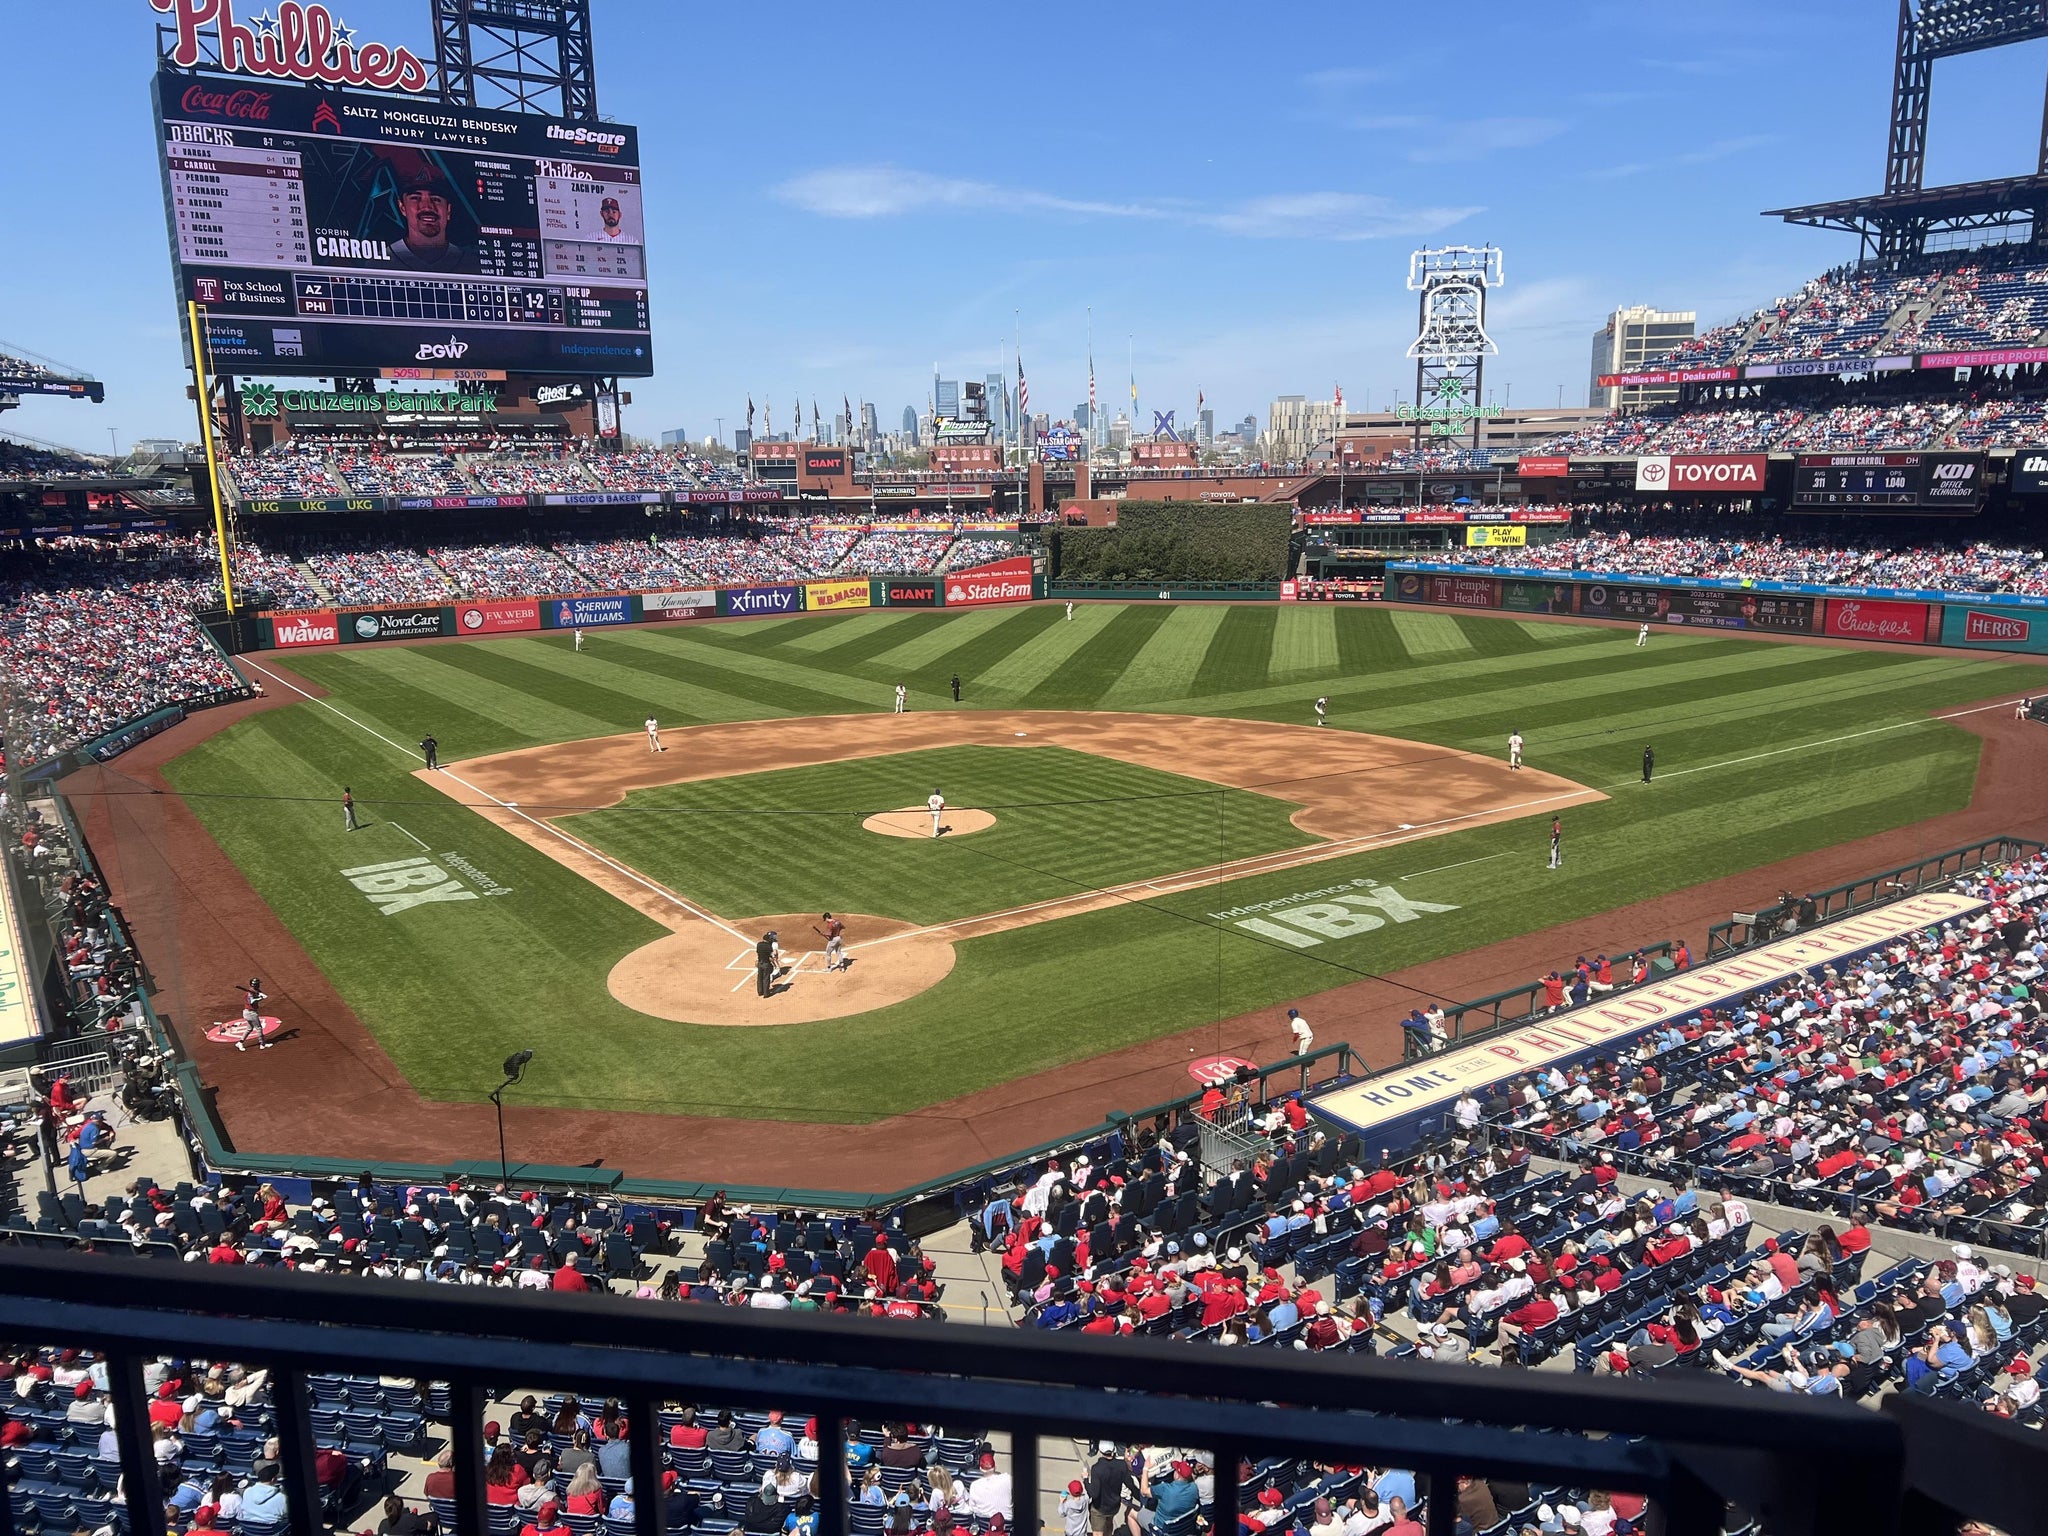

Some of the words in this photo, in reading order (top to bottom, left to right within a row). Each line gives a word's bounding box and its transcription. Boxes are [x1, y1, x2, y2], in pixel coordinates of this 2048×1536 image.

[150, 0, 428, 92] Phillies
[181, 84, 272, 120] Coca-Cola
[343, 105, 378, 119] SALTZ
[383, 110, 457, 128] MONGELUZZI
[462, 119, 518, 134] BENDESKY
[380, 126, 425, 139] INJURY
[434, 132, 488, 145] LAWYERS
[546, 125, 626, 147] theScore
[183, 148, 211, 158] VARGAS
[184, 161, 216, 171] CARROLL
[283, 169, 299, 178] 1.040
[488, 162, 511, 171] SEQUENCE
[535, 159, 593, 181] Phillies
[186, 173, 220, 183] PERDOMO
[187, 186, 229, 197] FERNANDEZ
[571, 182, 590, 193] ZACH
[591, 184, 605, 194] POP
[189, 199, 222, 208] ARENADO
[192, 224, 223, 233] MCCANN
[315, 227, 349, 237] CORBIN
[499, 228, 513, 236] STATS
[194, 236, 223, 245] THOMAS
[195, 249, 228, 258] BARROSA
[316, 236, 391, 261] CARROLL
[223, 280, 244, 291] Fox
[246, 281, 282, 293] School
[224, 292, 237, 301] of
[239, 293, 286, 304] Business
[305, 284, 322, 295] AZ
[526, 293, 545, 309] 1-2
[567, 287, 580, 297] DUE
[581, 288, 590, 298] UP
[305, 301, 326, 312] PHI
[580, 299, 600, 307] TURNER
[581, 309, 611, 318] SCHWARBER
[581, 319, 601, 327] HARPER
[205, 327, 243, 337] Driving
[206, 347, 262, 355] outcomes.
[419, 344, 462, 360] PGW
[561, 344, 631, 355] Independence
[1927, 355, 1960, 366] WHEY
[1963, 352, 2005, 364] BETTER
[393, 368, 421, 379] 5050
[1776, 363, 1824, 376] LISCIO'S
[1828, 360, 1876, 373] BAKERY
[454, 370, 488, 379] $30,190
[1621, 375, 1649, 384] Phillies
[1650, 375, 1664, 383] win
[1683, 371, 1706, 381] Deals
[1707, 371, 1721, 380] roll
[1722, 371, 1730, 379] in
[282, 389, 382, 412] Citizens
[386, 389, 445, 412] Bank
[447, 389, 498, 412] Park
[1398, 404, 1459, 419] Citizens
[1462, 402, 1502, 417] Bank
[1431, 420, 1466, 435] Park
[808, 459, 841, 467] GIANT
[1831, 456, 1856, 466] CORBIN
[1856, 456, 1886, 466] CARROLL
[1906, 456, 1919, 465] DH
[1675, 464, 1757, 482] TOYOTA
[1933, 464, 1975, 479] KDI
[1812, 477, 1826, 488] .311
[1841, 477, 1846, 488] 2
[1866, 477, 1873, 488] 11
[1885, 477, 1905, 488] 1.040
[1940, 480, 1964, 489] OFFICE
[564, 493, 604, 503] LISCIO'S
[606, 493, 643, 503] BAKERY
[692, 492, 726, 501] TOYOTA
[745, 491, 779, 500] TOYOTA
[1929, 488, 1973, 497] TECHNOLOGY
[251, 503, 279, 512] UKG
[300, 501, 327, 511] UKG
[346, 500, 373, 510] UKG
[436, 498, 466, 508] NECA
[500, 496, 527, 506] NECA
[1501, 535, 1521, 543] WIN!
[1454, 578, 1490, 592] Temple
[486, 596, 526, 604] ASPLUNDH
[534, 593, 574, 601] ASPLUNDH
[890, 589, 934, 600] GIANT
[1158, 591, 1170, 600] 401
[1454, 592, 1488, 605] Health
[1944, 594, 1986, 602] Independence
[383, 602, 427, 610] ASPLUNDH
[435, 599, 478, 607] ASPLUNDH
[657, 595, 701, 608] Yuengling
[732, 589, 792, 612] xfinity
[329, 605, 375, 614] ASPLUNDH
[574, 600, 622, 613] SHERWIN
[273, 609, 320, 617] ASPLUNDH
[506, 609, 535, 619] WEBB
[665, 609, 696, 618] LAGER
[380, 614, 440, 629] NovaCare
[1690, 617, 1713, 625] SINKER
[1716, 618, 1725, 626] 98
[1837, 607, 1912, 636] Chick-fil-A
[381, 627, 438, 636] REHABILITATION
[1972, 619, 2022, 637] HERR'S
[278, 626, 336, 644] Wawa
[440, 851, 499, 889] Independence
[339, 856, 479, 916] IBX
[1206, 882, 1354, 921] Independence
[1233, 885, 1462, 949] IBX
[1360, 1069, 1458, 1107] HOME
[1455, 1064, 1471, 1073] OF
[1472, 1057, 1491, 1068] THE
[1485, 951, 1808, 1064] PHILADELPHIA
[1801, 897, 1962, 953] PHILLIES
[1735, 1211, 1742, 1224] 8
[1969, 1280, 1976, 1293] 3
